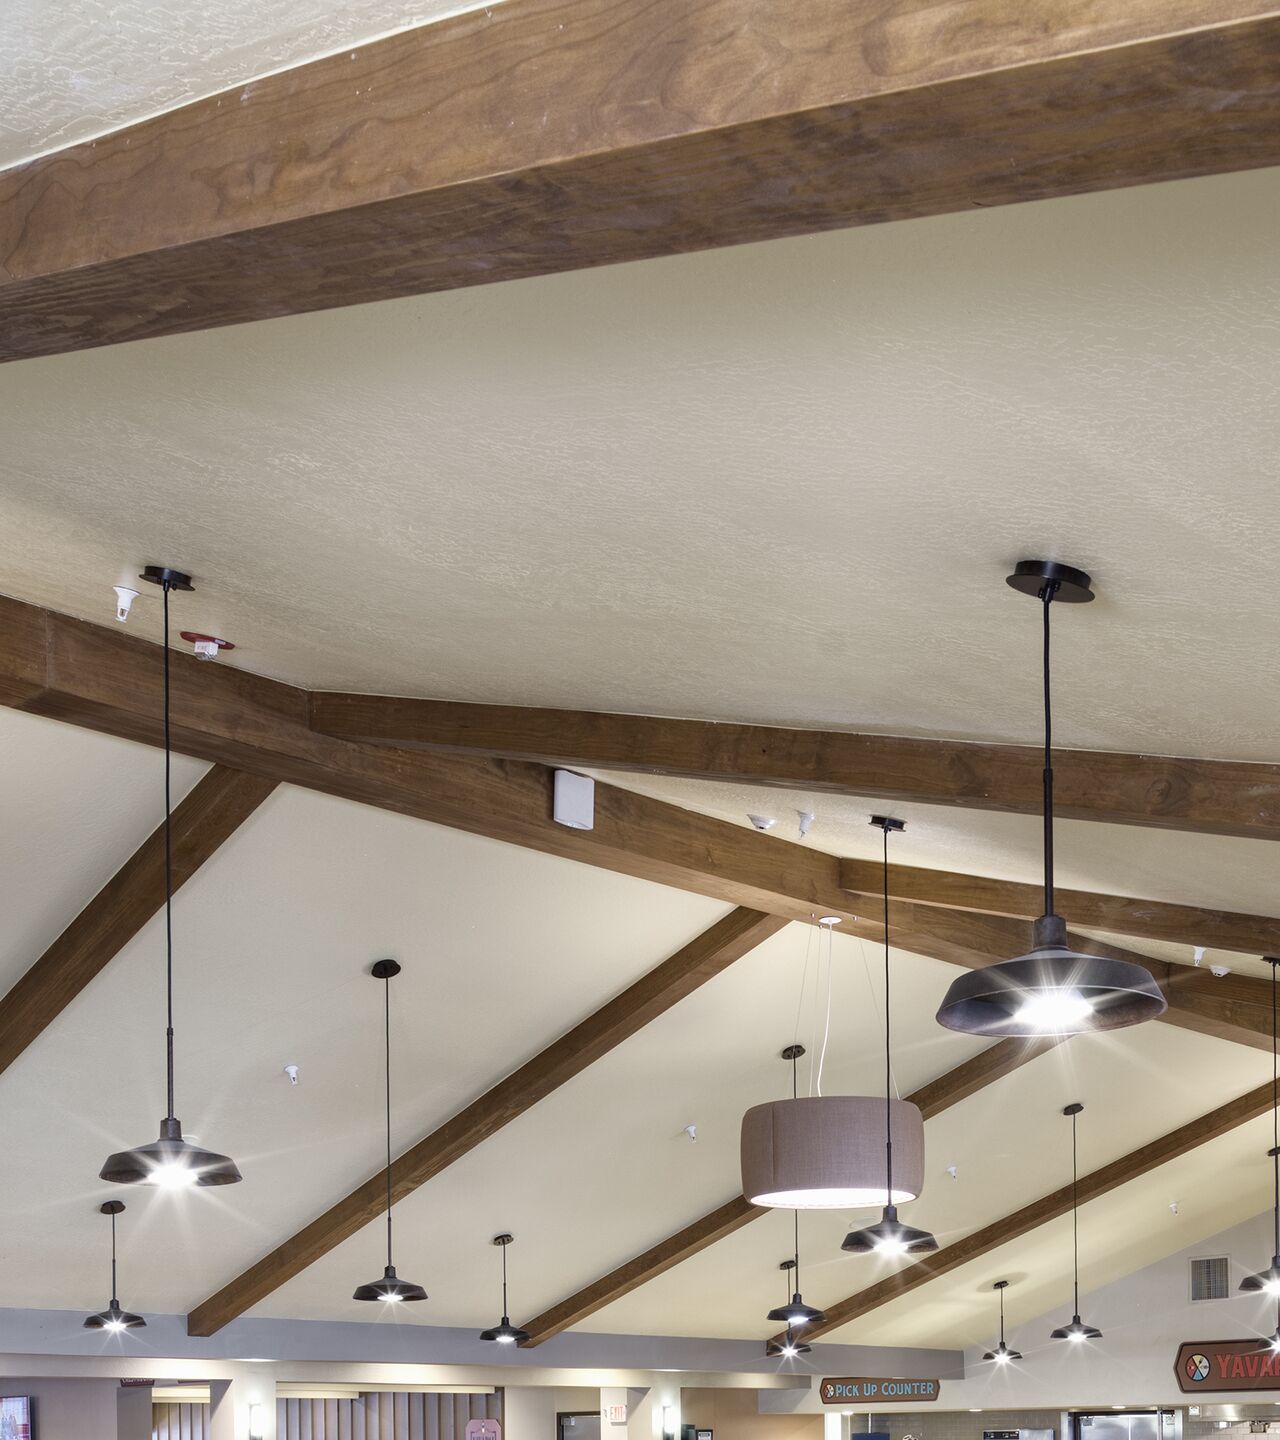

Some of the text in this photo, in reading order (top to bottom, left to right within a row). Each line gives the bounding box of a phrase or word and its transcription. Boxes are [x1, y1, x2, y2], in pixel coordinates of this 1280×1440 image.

[835, 1382, 934, 1397] PICK UP COUNTER
